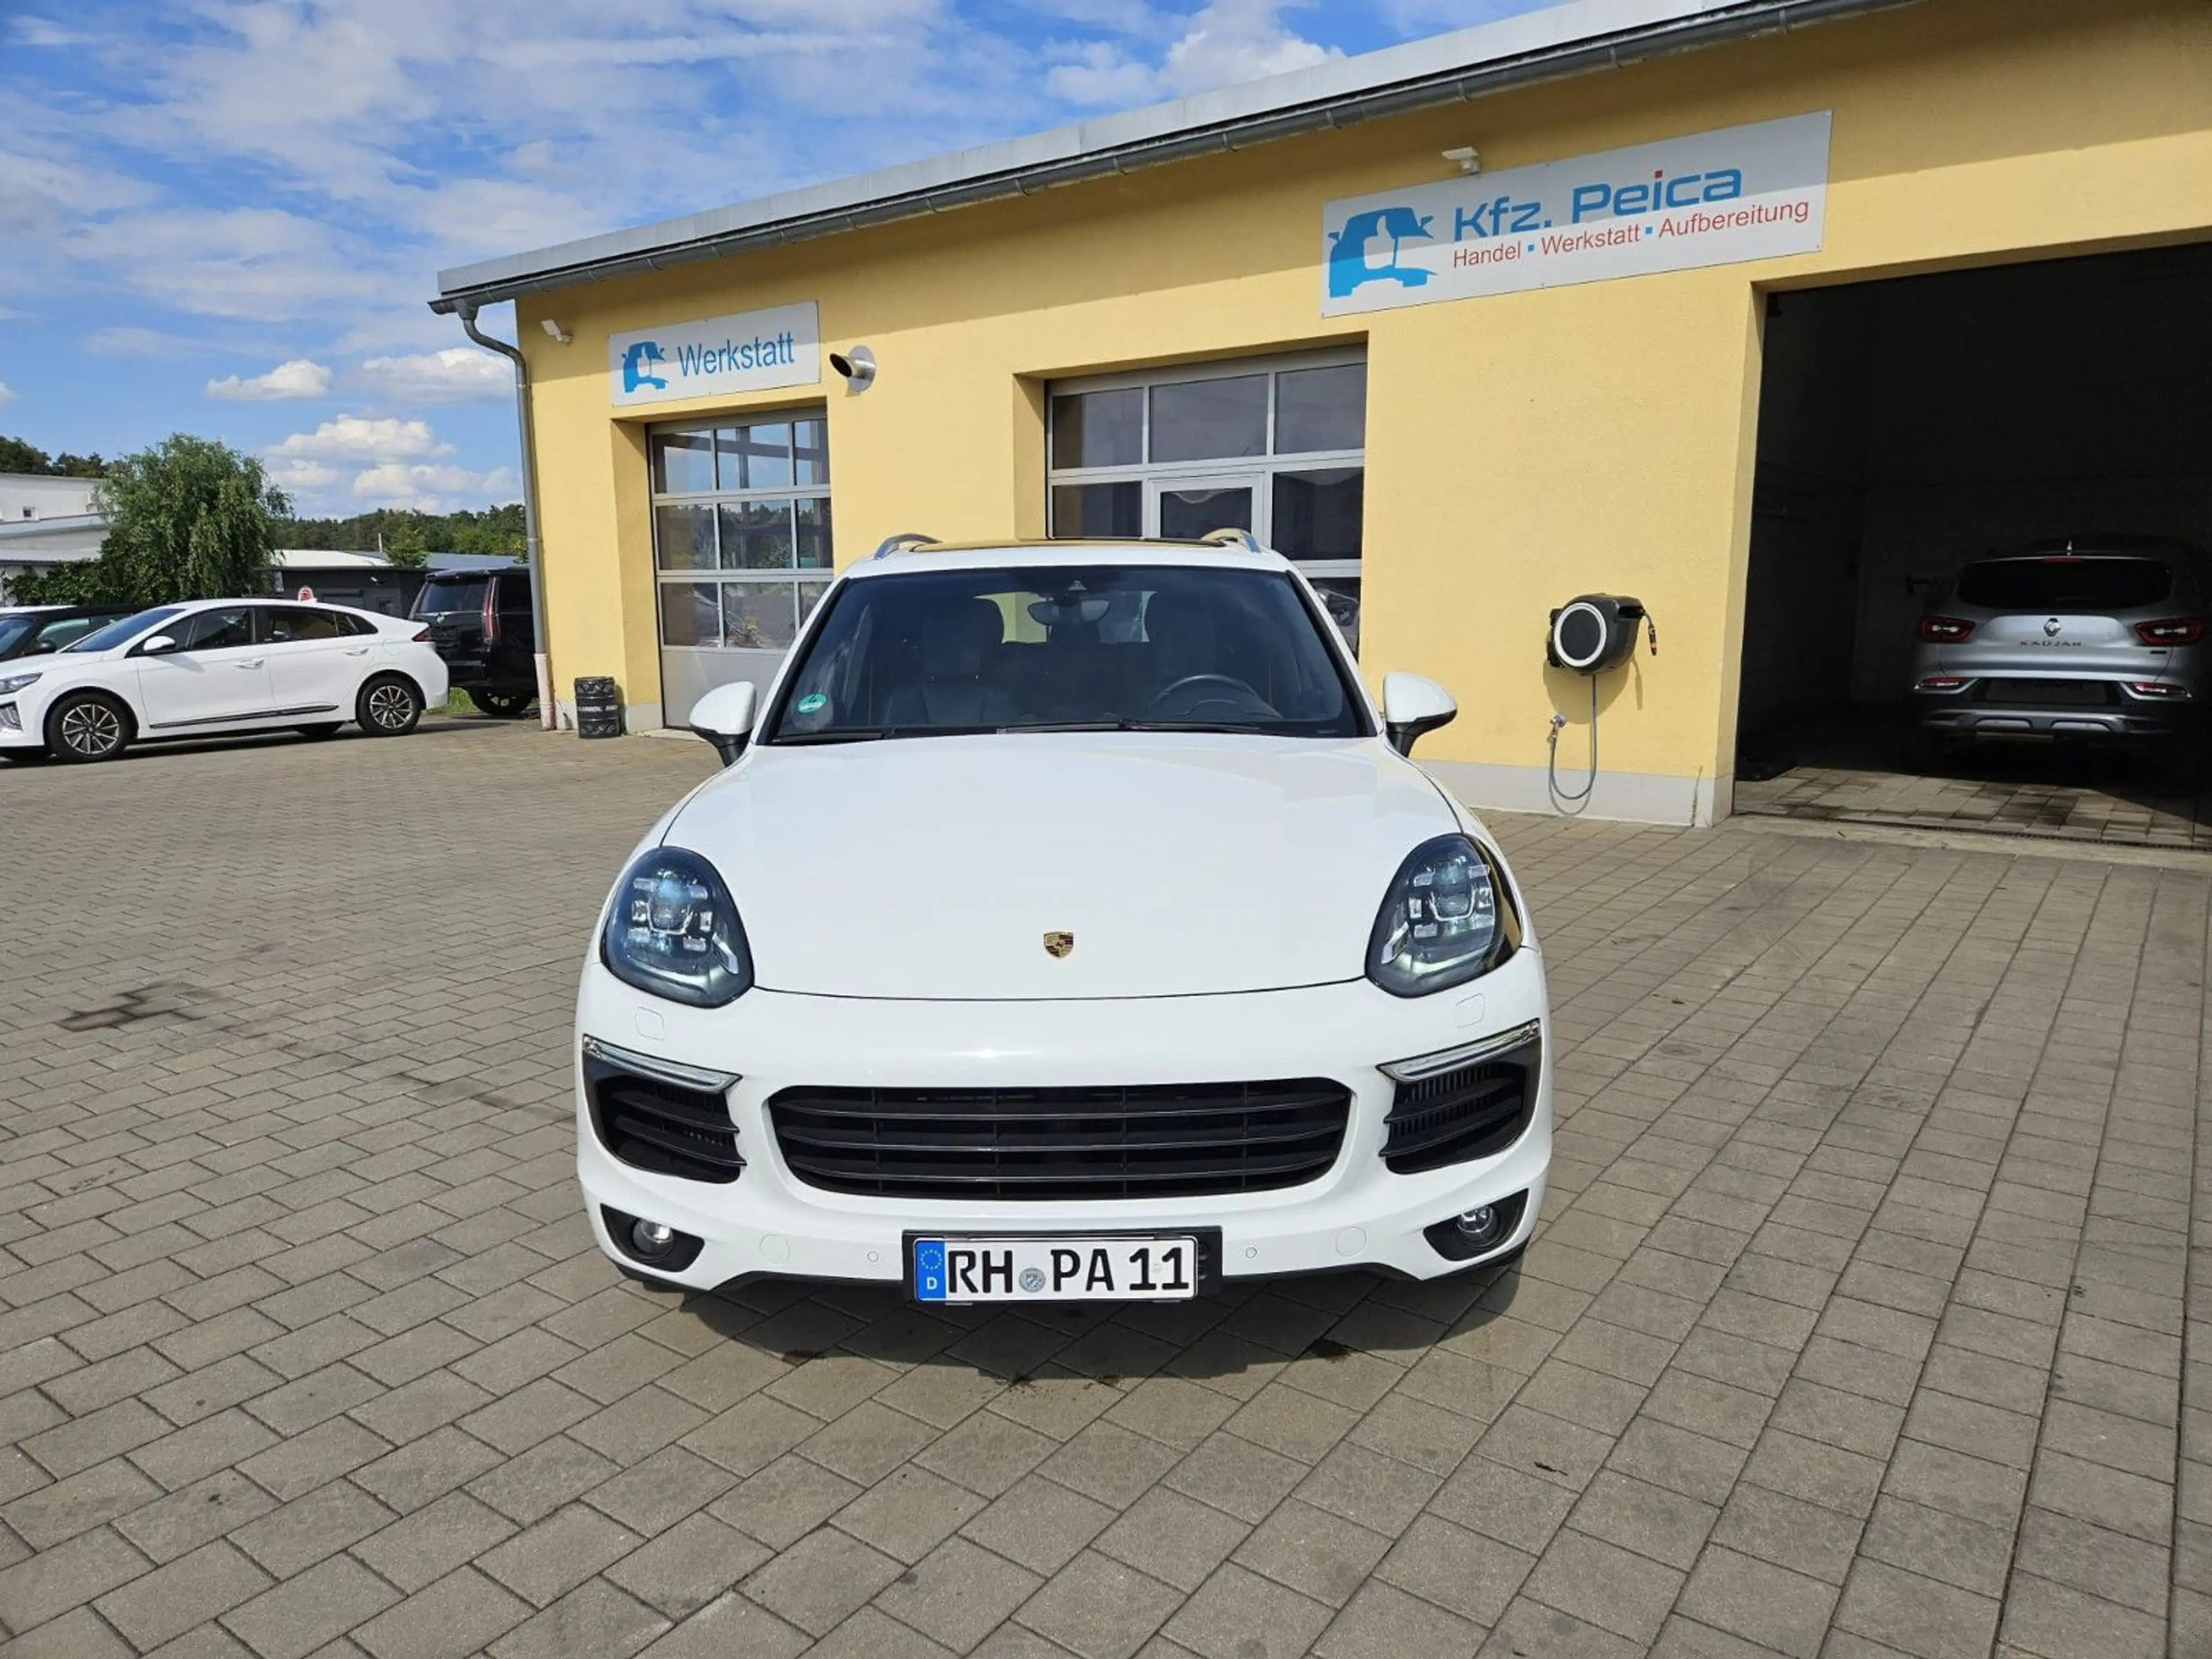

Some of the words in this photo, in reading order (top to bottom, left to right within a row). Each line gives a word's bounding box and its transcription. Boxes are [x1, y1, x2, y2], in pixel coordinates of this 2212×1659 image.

[1453, 196, 1552, 243] Kfz.
[1571, 168, 1742, 225] Peica
[1453, 240, 1521, 268] Handel
[1541, 224, 1641, 256] Werkstatt
[1658, 199, 1810, 238] Aufbereitung
[677, 331, 795, 377] Werkstatt
[926, 1277, 938, 1290] D
[948, 1250, 1013, 1294] RH
[1050, 1248, 1115, 1292] PA
[1128, 1247, 1190, 1291] 11
